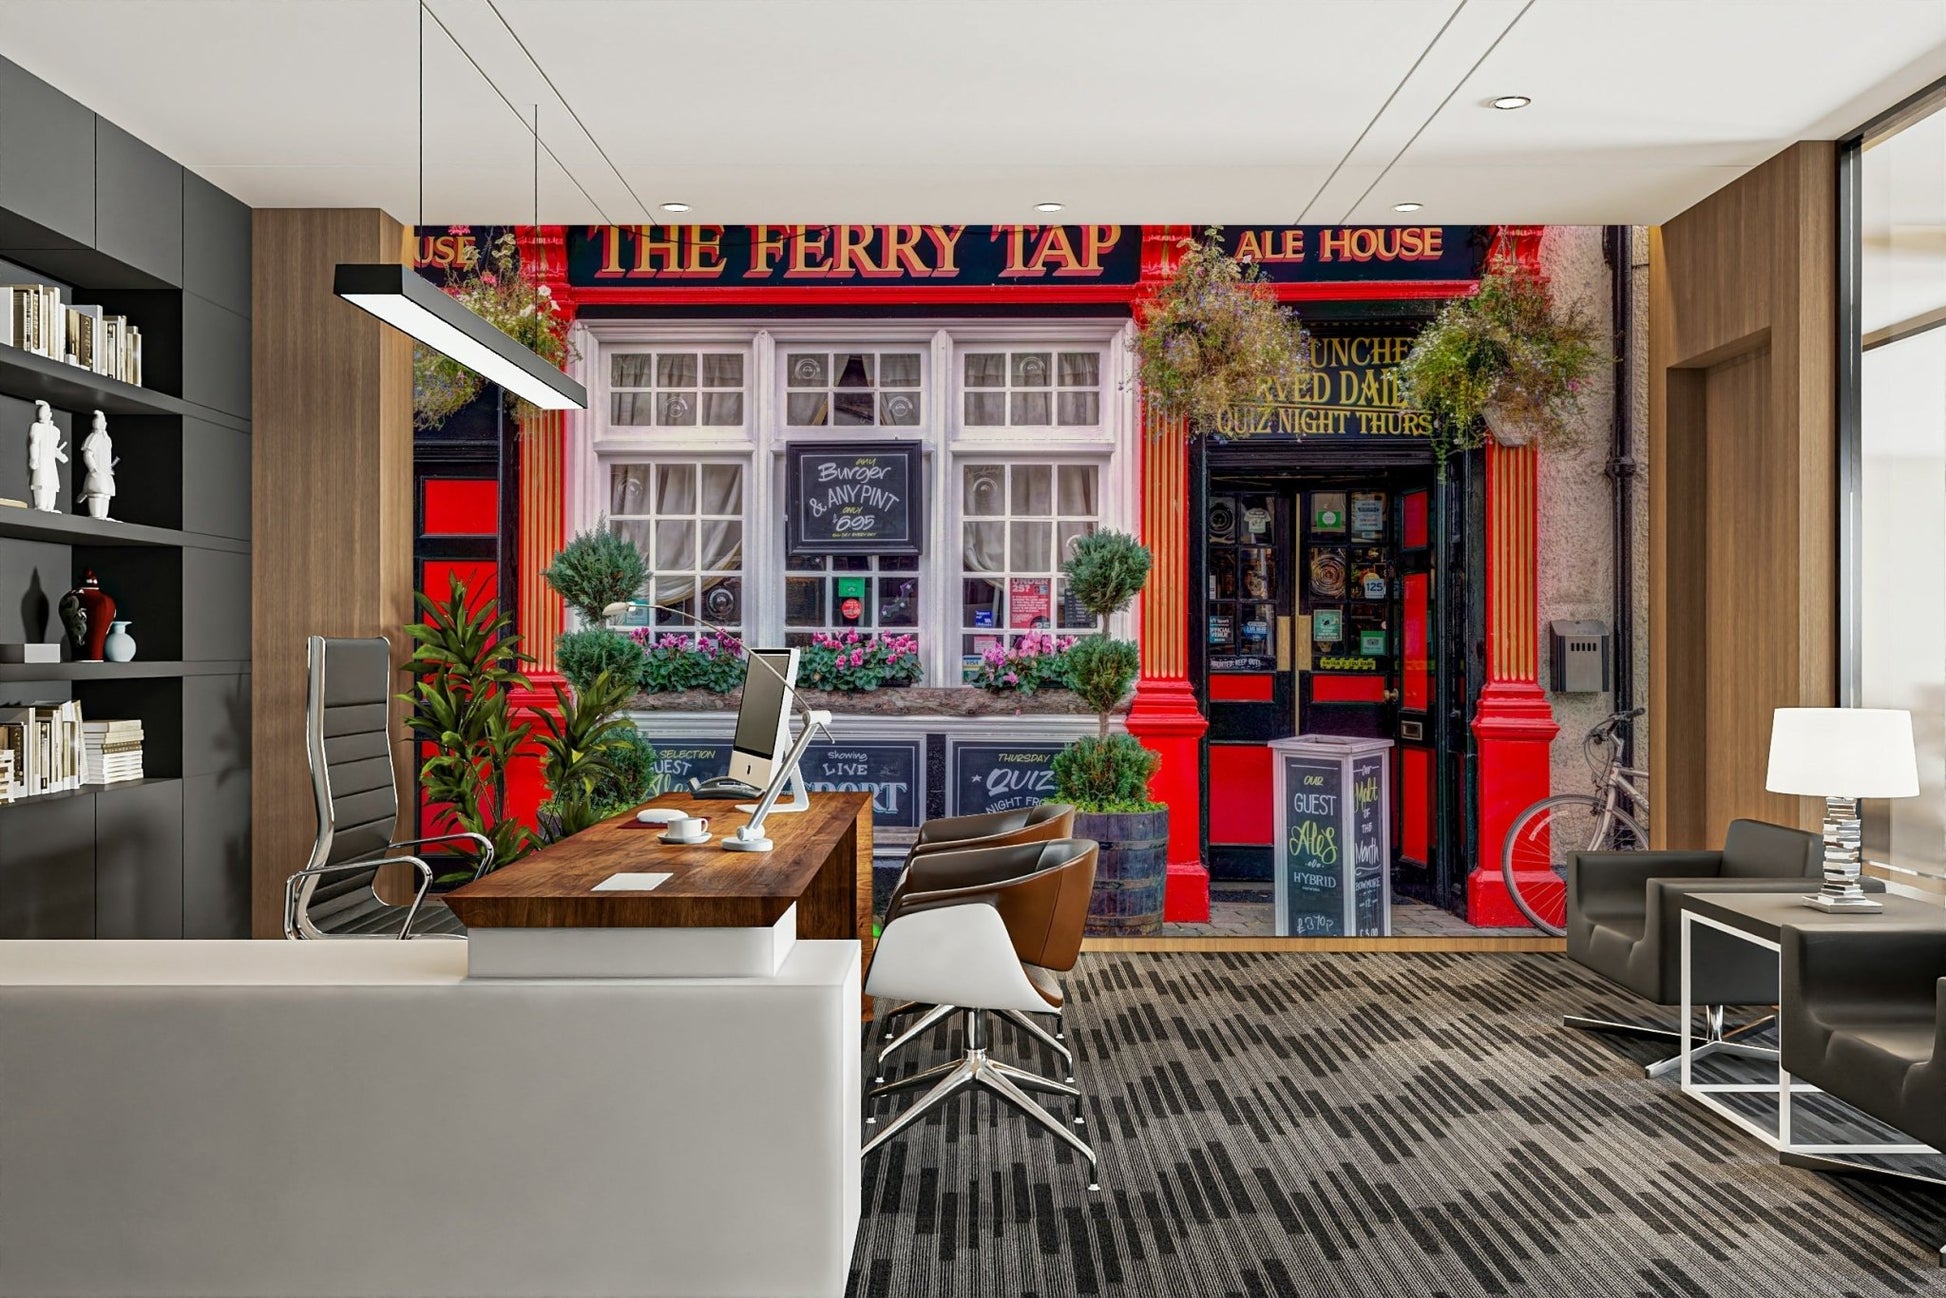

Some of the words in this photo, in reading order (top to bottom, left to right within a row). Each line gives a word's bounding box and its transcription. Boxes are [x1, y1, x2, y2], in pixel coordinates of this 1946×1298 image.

[414, 236, 476, 268] USE
[588, 224, 728, 278] THE
[743, 224, 968, 278] FERRY
[991, 224, 1122, 277] TAP
[1234, 230, 1305, 262] ALE
[1319, 227, 1443, 262] HOUSE
[1305, 337, 1414, 368] UNCHE
[1340, 368, 1416, 407] DAIL
[1217, 408, 1273, 438] QUIZ
[1278, 408, 1350, 434] NIGHT
[1355, 411, 1434, 436] THURS
[818, 462, 891, 484] Burger
[809, 498, 827, 517] &
[828, 484, 860, 508] ANY
[861, 485, 899, 512] PINT
[1366, 581, 1384, 592] 125
[660, 749, 716, 759] SELECTION
[998, 753, 1051, 763] THURSDAY
[823, 763, 868, 776] LIVE
[986, 768, 1056, 797] QUIZ
[985, 796, 1022, 814] NIGHT
[1294, 792, 1337, 816] GUEST
[1293, 872, 1336, 888] HYBRID
